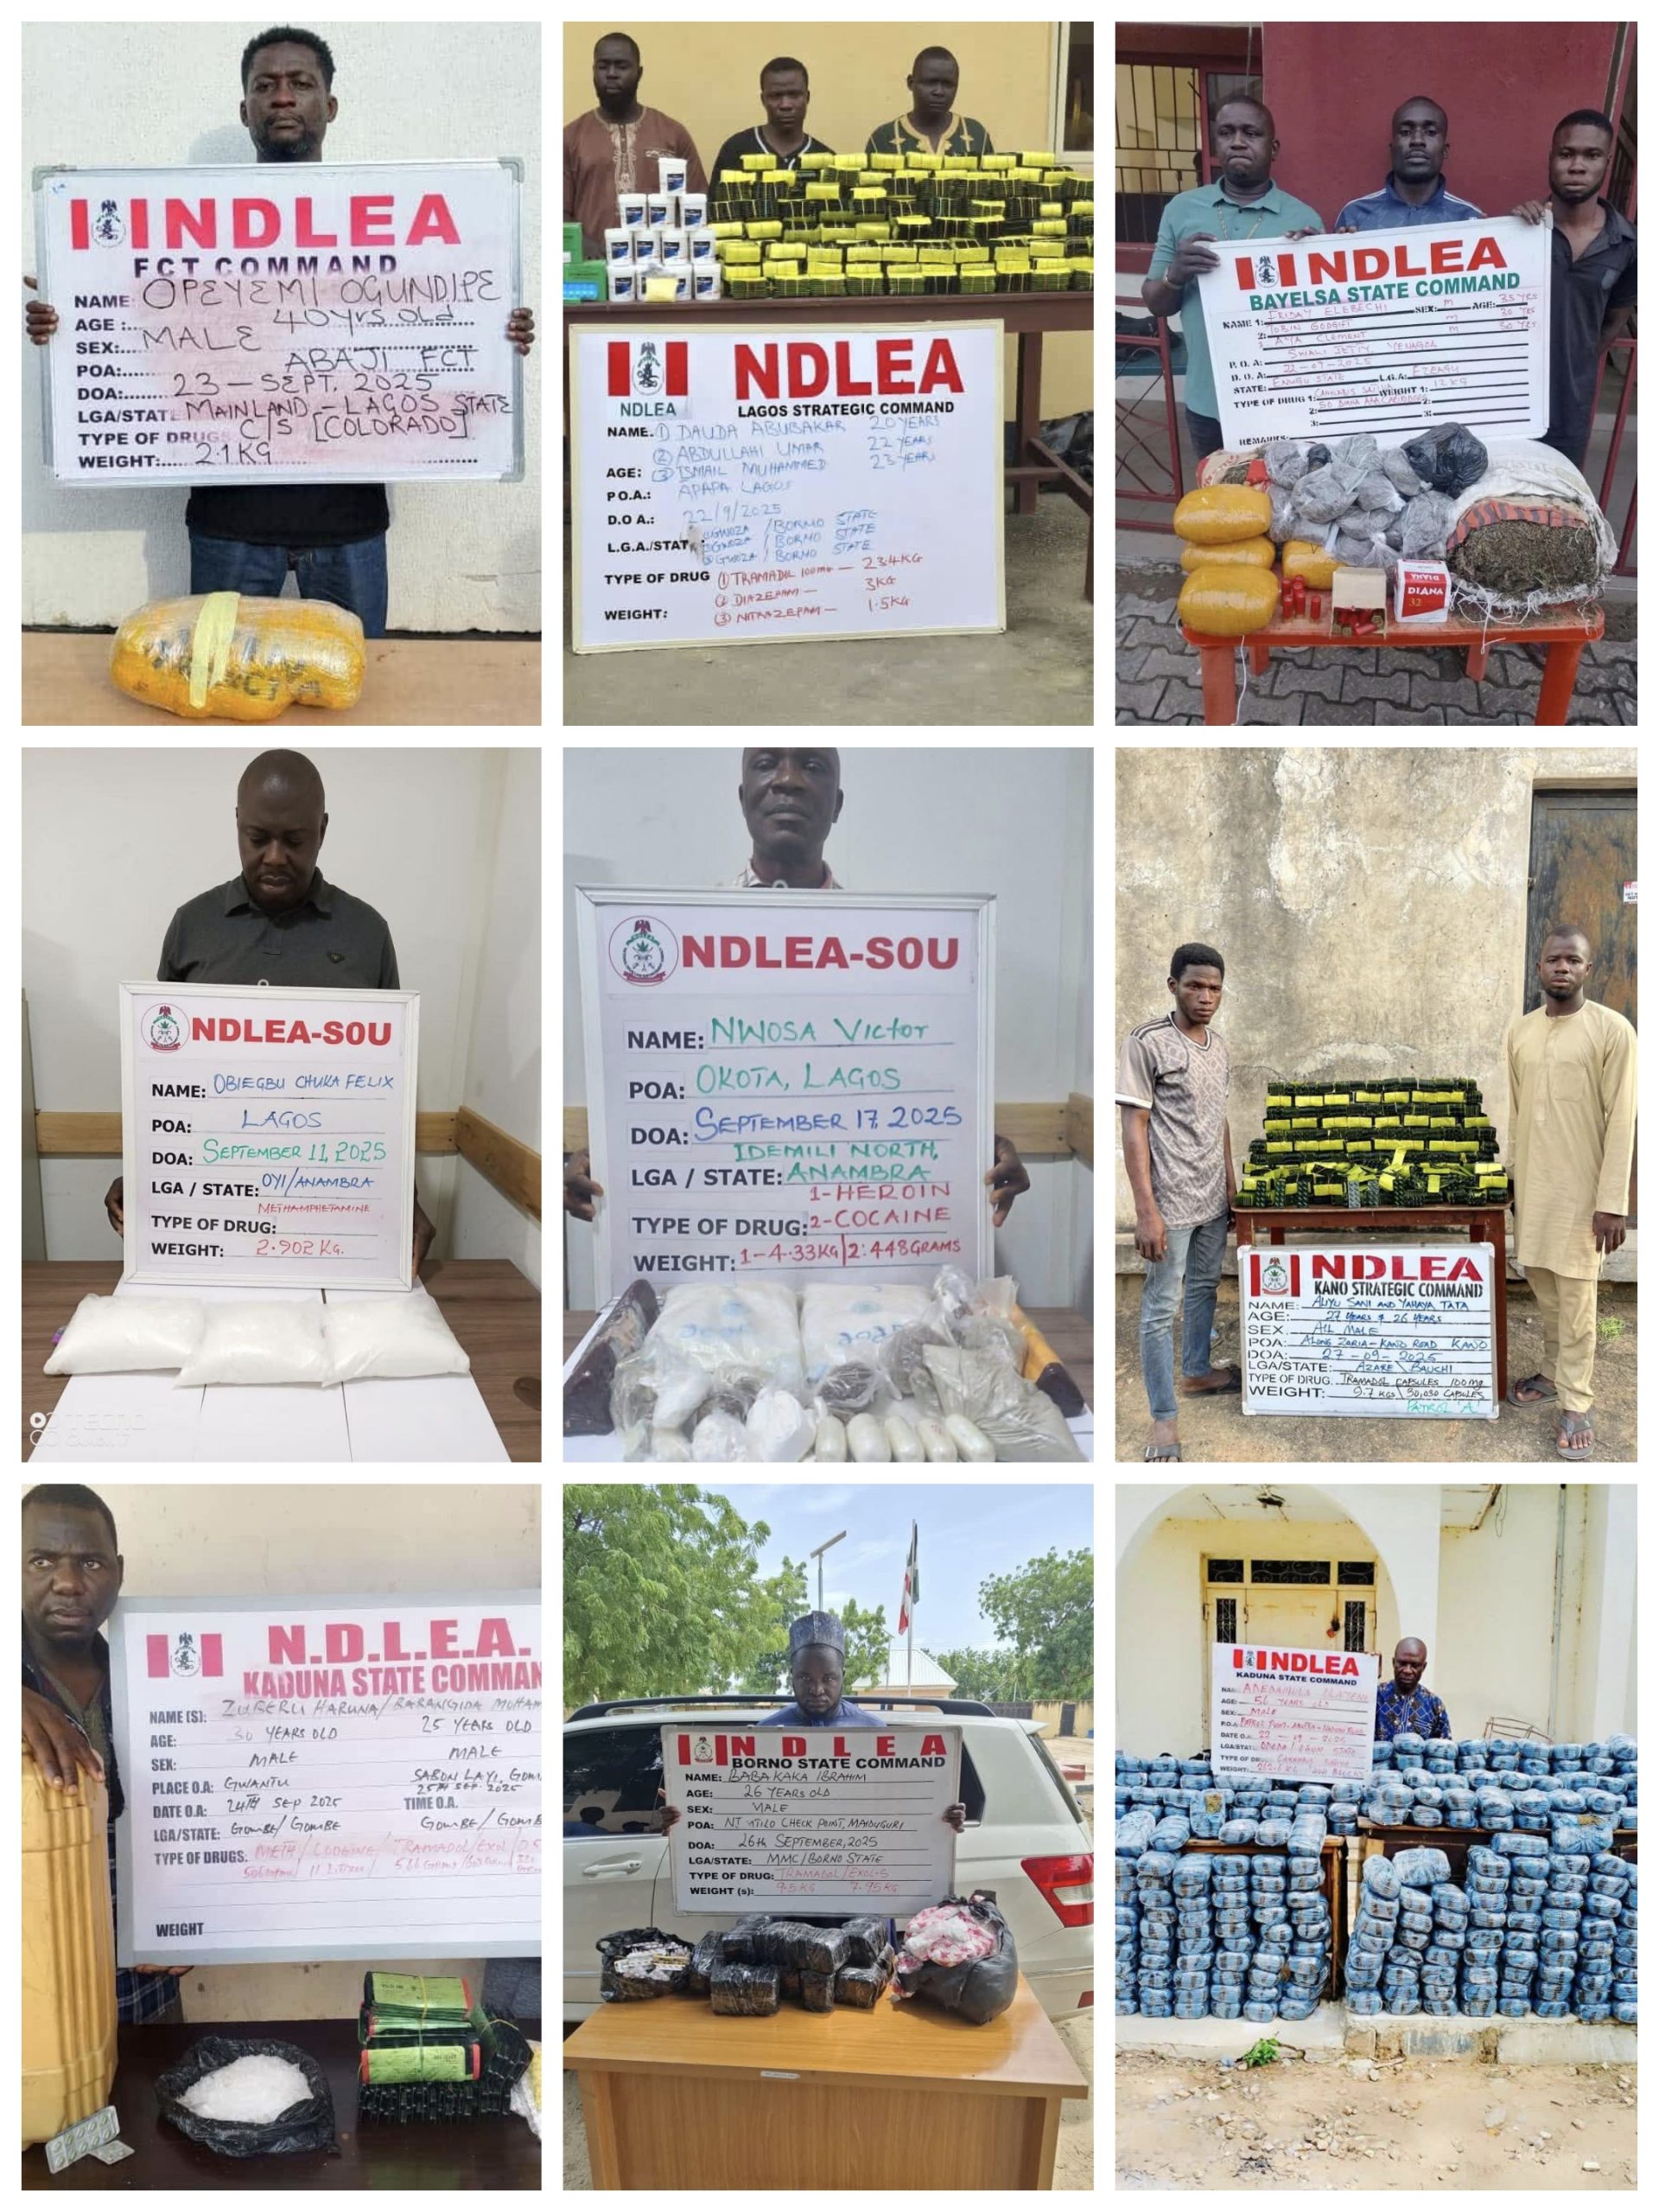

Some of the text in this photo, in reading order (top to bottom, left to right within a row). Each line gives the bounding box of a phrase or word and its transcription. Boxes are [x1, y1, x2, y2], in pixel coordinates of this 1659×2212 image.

[165, 194, 461, 250] NDLEA
[134, 254, 398, 277] FCT COMMAND
[1308, 237, 1508, 285] NDLEA
[143, 270, 501, 308] OPEYEMI OGUNDIPE
[1249, 271, 1520, 311] BAYELSA STATE COMMAND
[143, 327, 261, 351] MALE
[285, 347, 479, 373] ABAJI FCT
[734, 339, 964, 400] NDLEA
[174, 373, 219, 397] 23
[354, 373, 439, 391] 2025
[346, 394, 439, 415] LAGOS
[450, 394, 513, 414] STATE
[620, 402, 954, 417] NDLEA LAGOS STRATEGIC COMMAND
[79, 433, 159, 445] TYPE OF
[607, 468, 642, 478] AGE:
[605, 575, 642, 584] TYPE
[648, 573, 664, 583] OF
[670, 572, 710, 582] DRUG
[1408, 587, 1444, 595] DIANA
[605, 609, 667, 620] WEIGHT:
[627, 1017, 817, 1050] NAME: NWOSA
[152, 1073, 394, 1099] NAME: OBIEGBU CHUKA FELIX
[629, 1063, 901, 1100] POA: LAGOS
[152, 1109, 321, 1134] POA: LAGOS
[631, 1107, 963, 1146] DOA: SEPTEMBER 2025
[152, 1139, 386, 1166] DOA: SEPTEMBER 2025
[734, 1142, 836, 1162] IDEMILI
[632, 1163, 931, 1187] LGA STATE: ANAMBRA
[152, 1182, 259, 1198] LGA STATE:
[152, 1215, 276, 1234] TYPE OF DRUG:
[632, 1217, 808, 1237] TYPE OF DRUG:
[152, 1243, 224, 1258] WEIGHT:
[633, 1255, 735, 1272] WEIGHT:
[1312, 1255, 1483, 1281] NDLEA
[1314, 1281, 1483, 1298] KANO STRATEGIC COMMAND
[1347, 1297, 1371, 1307] SANI
[1440, 1300, 1469, 1310] TATA
[1248, 1312, 1289, 1321] AGE:
[1393, 1313, 1408, 1323] 26
[1249, 1338, 1287, 1347] POA:
[1248, 1350, 1287, 1360] DOA:
[1249, 1361, 1332, 1372] LGA/STATE:
[1249, 1373, 1276, 1382] TYPE
[1280, 1374, 1294, 1382] OF
[1249, 1386, 1325, 1398] WEIGHT:
[268, 1618, 531, 1665] N.D.L.E.A.
[1271, 1652, 1359, 1676] NDLEA
[243, 1666, 424, 1699] KADUNA STATE
[1279, 1674, 1306, 1682] STATE
[1310, 1677, 1357, 1686] COMMAND
[149, 1711, 182, 1724] NAME
[150, 1734, 176, 1748] AGE:
[151, 1758, 177, 1771] SEX:
[448, 1745, 503, 1760] MALE
[732, 1757, 946, 1769] BORNO STATE COMMAND
[153, 1781, 189, 1795] PLACE
[744, 1784, 762, 1797] 26
[154, 1805, 181, 1818] DATE
[404, 1797, 434, 1810] TIME
[154, 1827, 220, 1842] LGA/STATE:
[155, 1853, 184, 1866] TYPE
[187, 1852, 200, 1865] OF
[156, 1922, 205, 1937] WEIGHT
